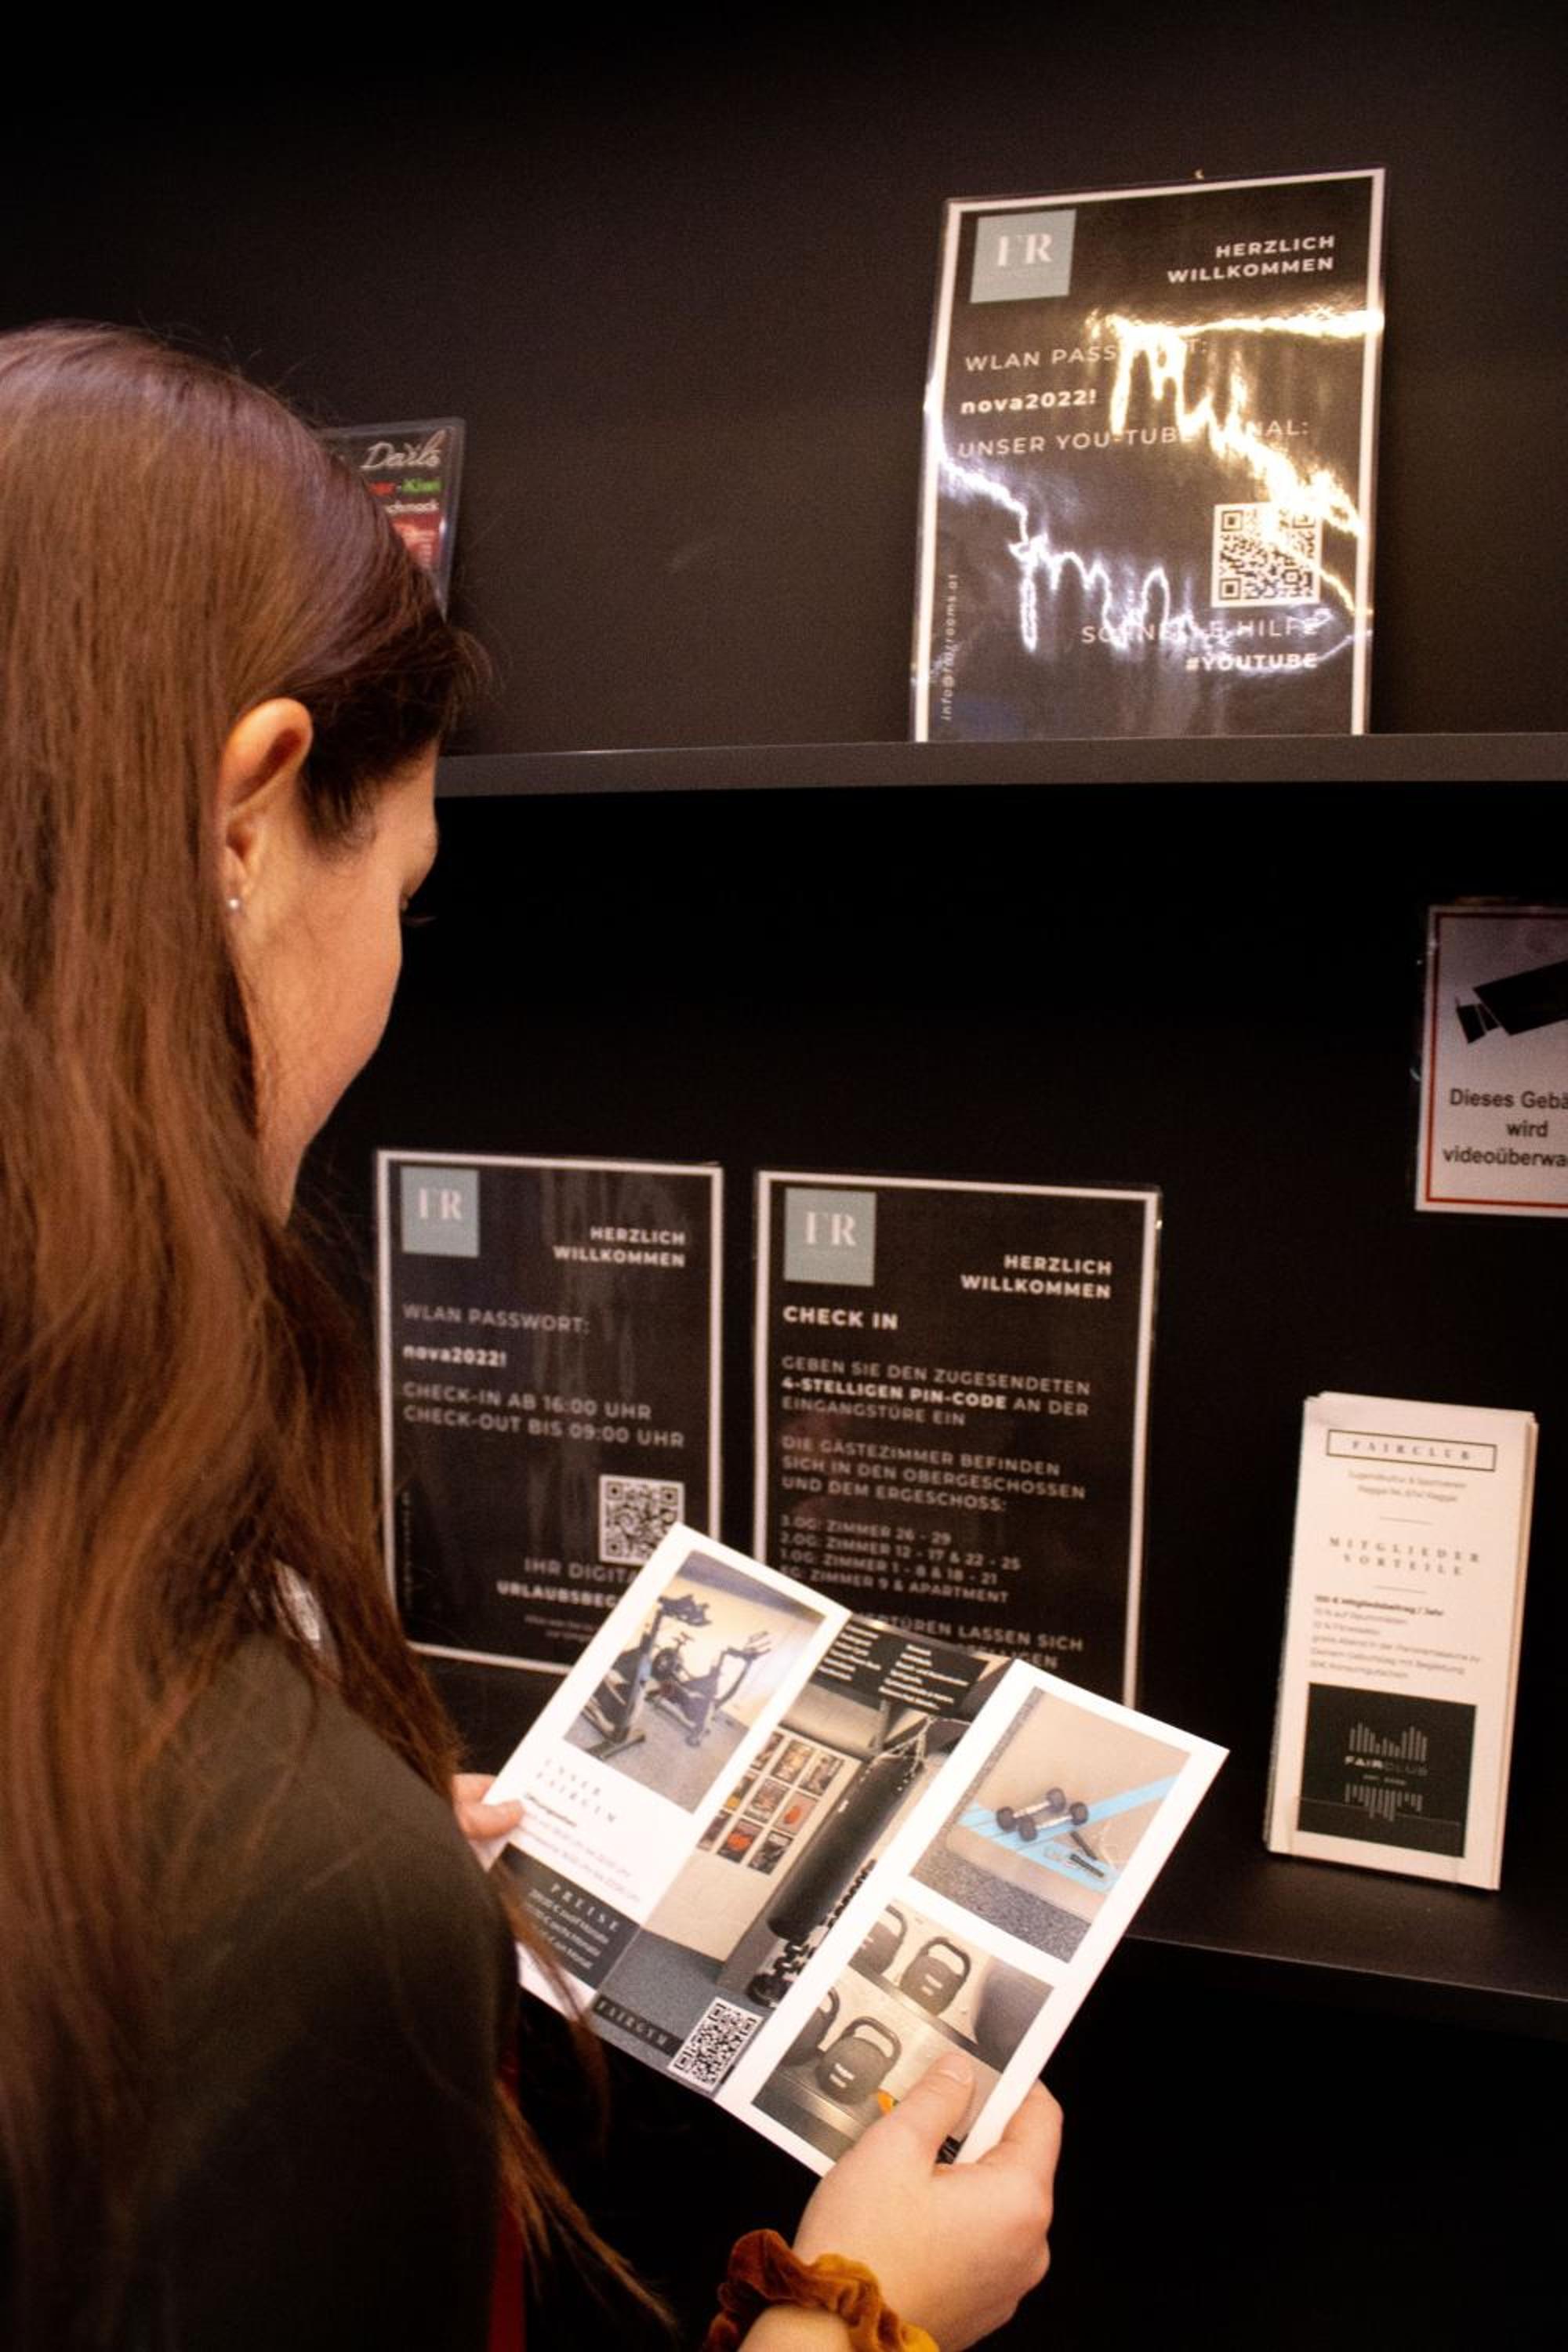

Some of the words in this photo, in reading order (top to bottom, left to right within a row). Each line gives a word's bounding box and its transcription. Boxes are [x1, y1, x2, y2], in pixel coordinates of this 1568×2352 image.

[1216, 235, 1334, 259] HERZLICH
[1167, 256, 1334, 284] WILLKOMMEN
[965, 352, 1039, 372] WLAN
[1051, 338, 1208, 365] PASST:
[960, 390, 1097, 414] nova2022!
[958, 437, 1045, 459] UNSER
[1186, 652, 1318, 672] #YOUTUBE
[1450, 1087, 1515, 1107] Dieses
[1506, 1119, 1548, 1138] wird
[590, 1225, 686, 1246] HERZLICH
[553, 1245, 686, 1268] WILLKOMMEN
[1004, 1254, 1112, 1276] HERZLICH
[960, 1274, 1111, 1299] WILLKOMMEN
[402, 1304, 462, 1323] WLAN
[470, 1307, 590, 1334] PASSWORT:
[783, 1305, 863, 1327] CHECK
[872, 1312, 898, 1331] IN
[403, 1345, 507, 1368] nova2022!
[783, 1356, 845, 1374] GEBEN
[851, 1360, 880, 1377] SIE
[887, 1364, 927, 1382] DEN
[933, 1368, 1091, 1396] ZUGESENDETEN
[402, 1382, 501, 1406] CHECK-IN
[507, 1393, 537, 1410] AB
[543, 1396, 597, 1417] 16:00
[604, 1402, 652, 1421] UHR
[782, 1377, 903, 1401] 4-STELLIGEN
[909, 1388, 1007, 1410] PIN-CODE
[1012, 1398, 1041, 1414] AN
[1048, 1400, 1089, 1418] DER
[783, 1396, 926, 1422] EINGANGSTÜRE
[932, 1410, 966, 1427] EIN
[402, 1405, 521, 1433] CHECK-OUT
[528, 1419, 563, 1438] BIS
[568, 1422, 630, 1443] 09:00
[637, 1428, 685, 1448] UHR
[783, 1436, 812, 1451] DIE
[820, 1438, 954, 1467] GÄSTEZIMMER
[960, 1454, 1060, 1476] BEFINDEN
[783, 1456, 825, 1472] SICH
[831, 1460, 851, 1475] IN
[857, 1463, 897, 1480] DEN
[904, 1467, 1086, 1500] OBERGESCHOSSEN
[782, 1476, 822, 1494] UND
[827, 1480, 869, 1497] DEM
[876, 1484, 1007, 1513] ERGESCHOSS:
[826, 1519, 891, 1538] ZIMMER
[931, 1531, 952, 1546] 29
[826, 1536, 891, 1555] ZIMMER
[895, 1543, 911, 1559] 12
[928, 1548, 946, 1562] 17
[949, 1550, 960, 1565] &
[524, 1557, 564, 1576] IHR
[822, 1552, 888, 1573] ZIMMER
[891, 1561, 899, 1573] 1
[981, 1572, 998, 1586] 21
[810, 1569, 874, 1588] ZIMMER
[909, 1581, 1009, 1604] APARTMENT
[958, 1624, 1031, 1647] LASSEN
[1036, 1634, 1083, 1651] SICH
